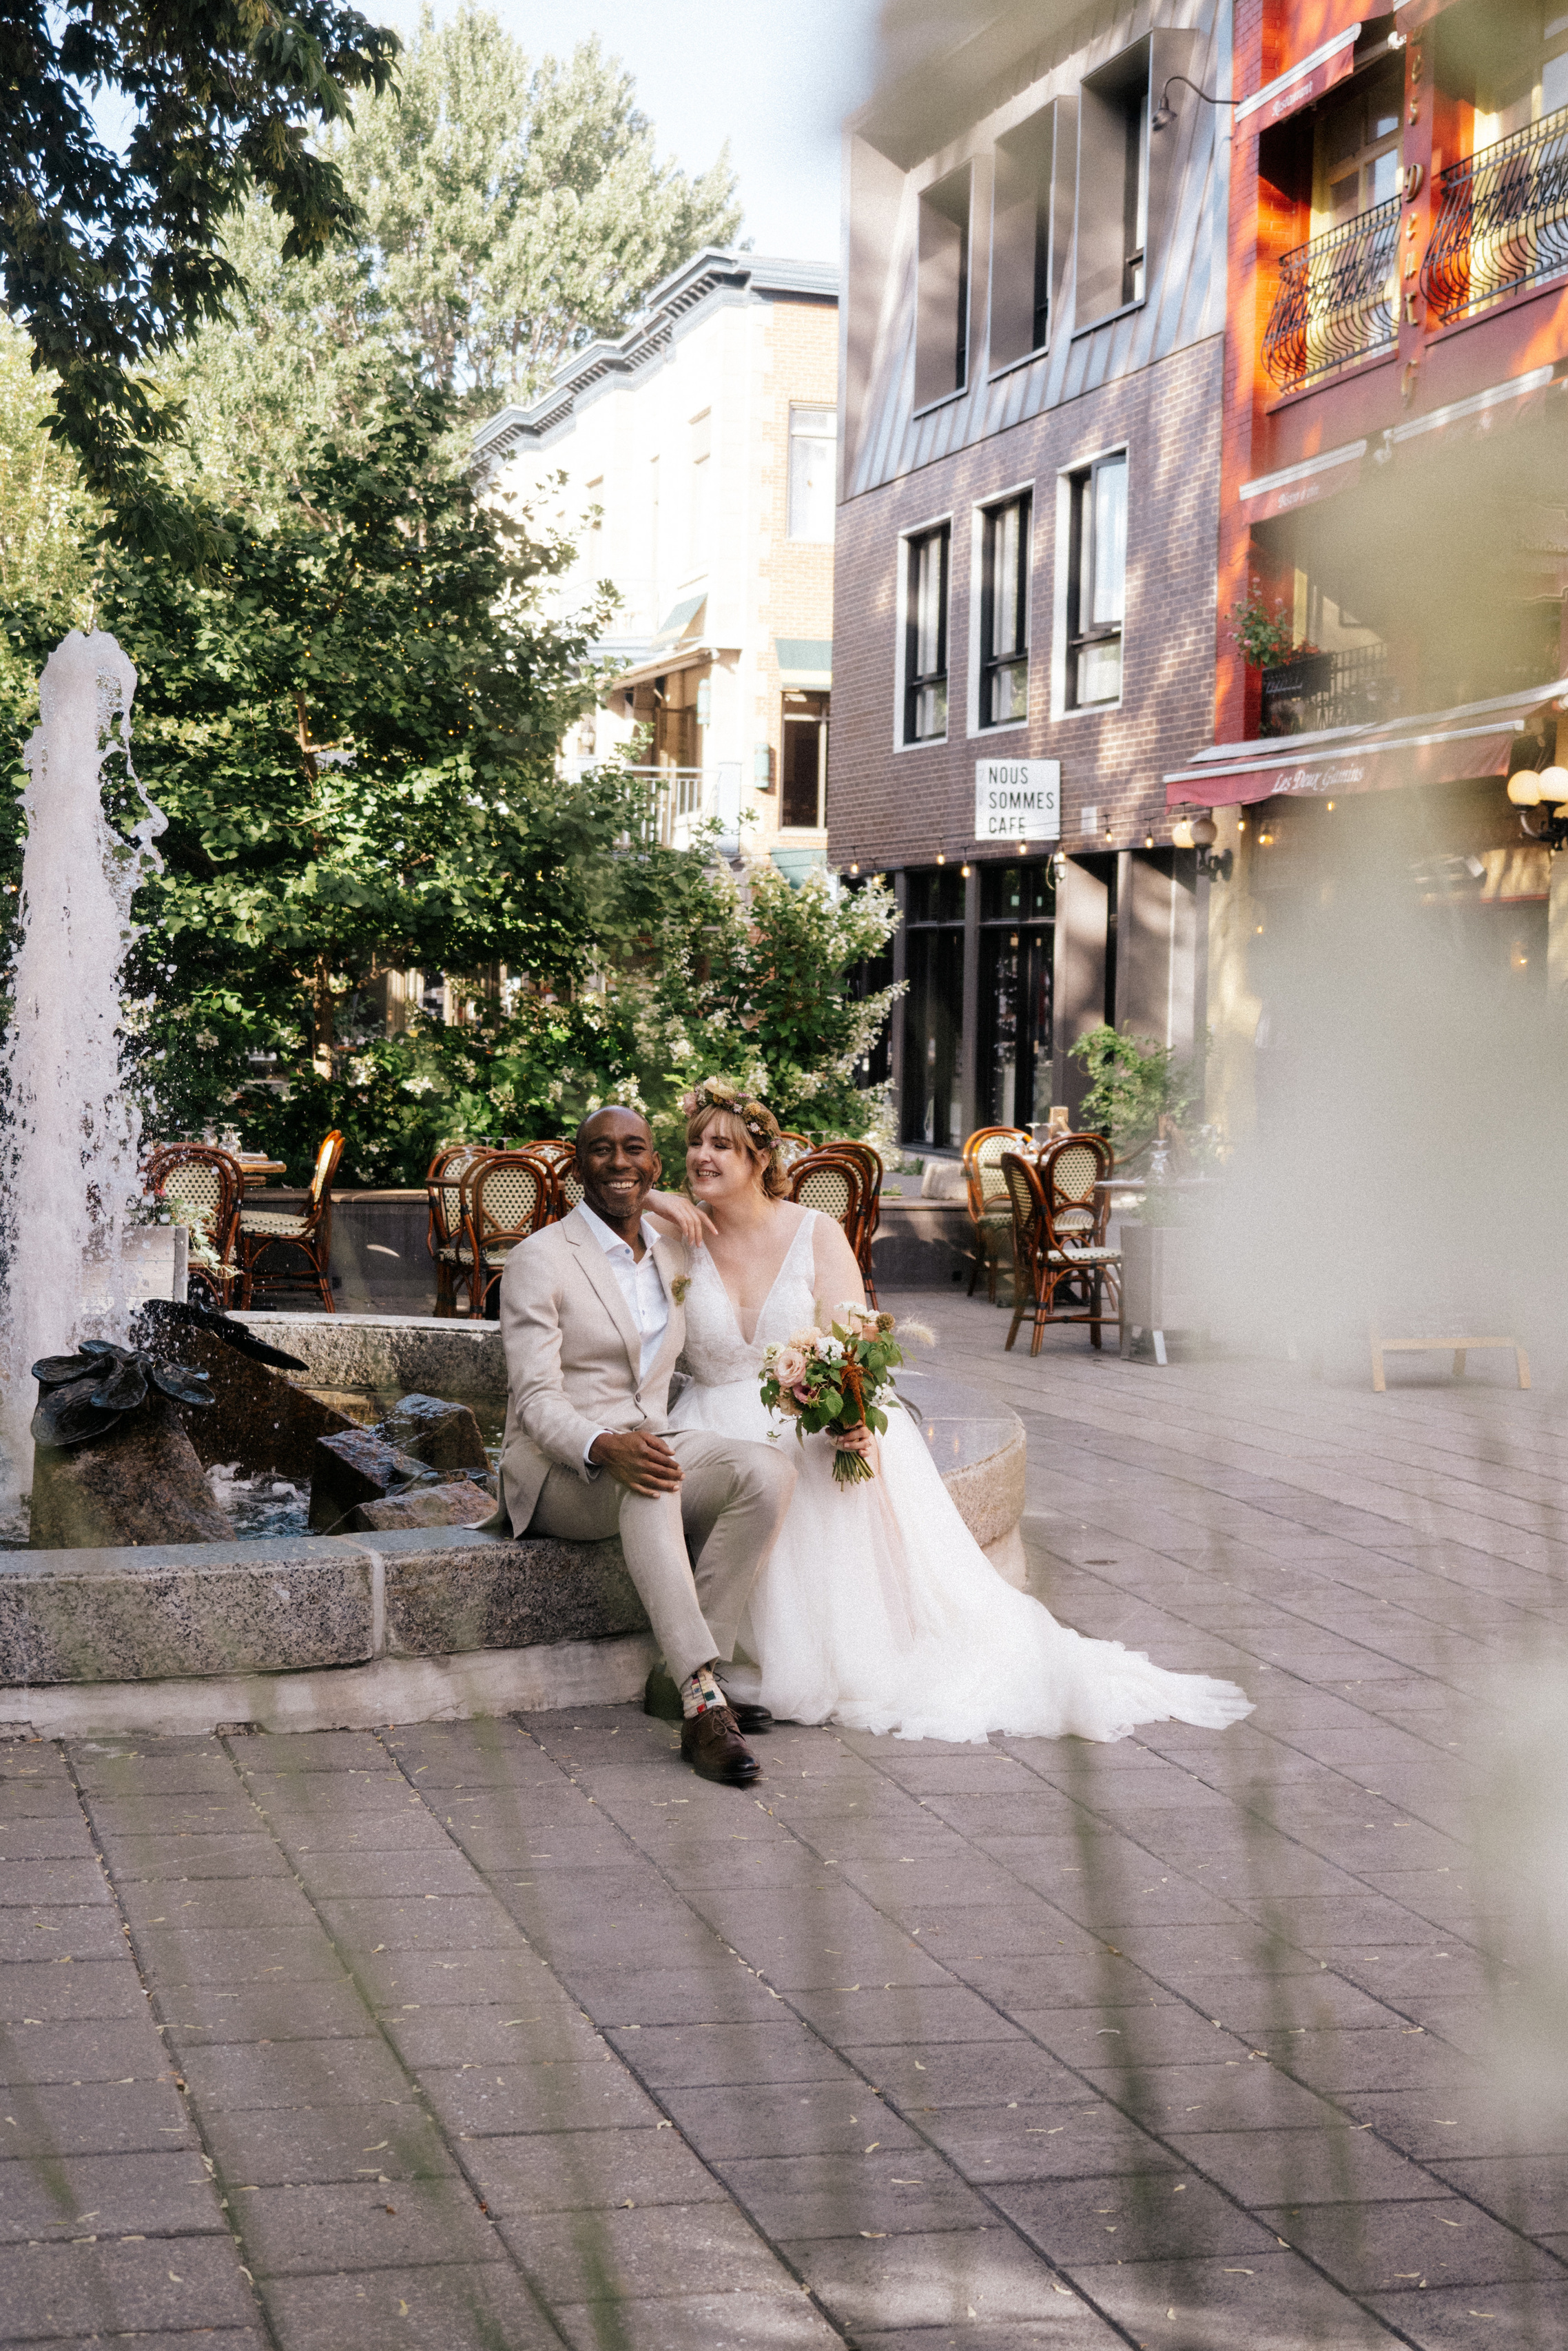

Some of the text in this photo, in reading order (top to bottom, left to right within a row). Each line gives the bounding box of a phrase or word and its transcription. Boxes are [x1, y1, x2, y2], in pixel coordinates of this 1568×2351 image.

[989, 766, 1028, 784] NOUS
[1271, 773, 1292, 793] Les
[989, 792, 1054, 810] SOMMES
